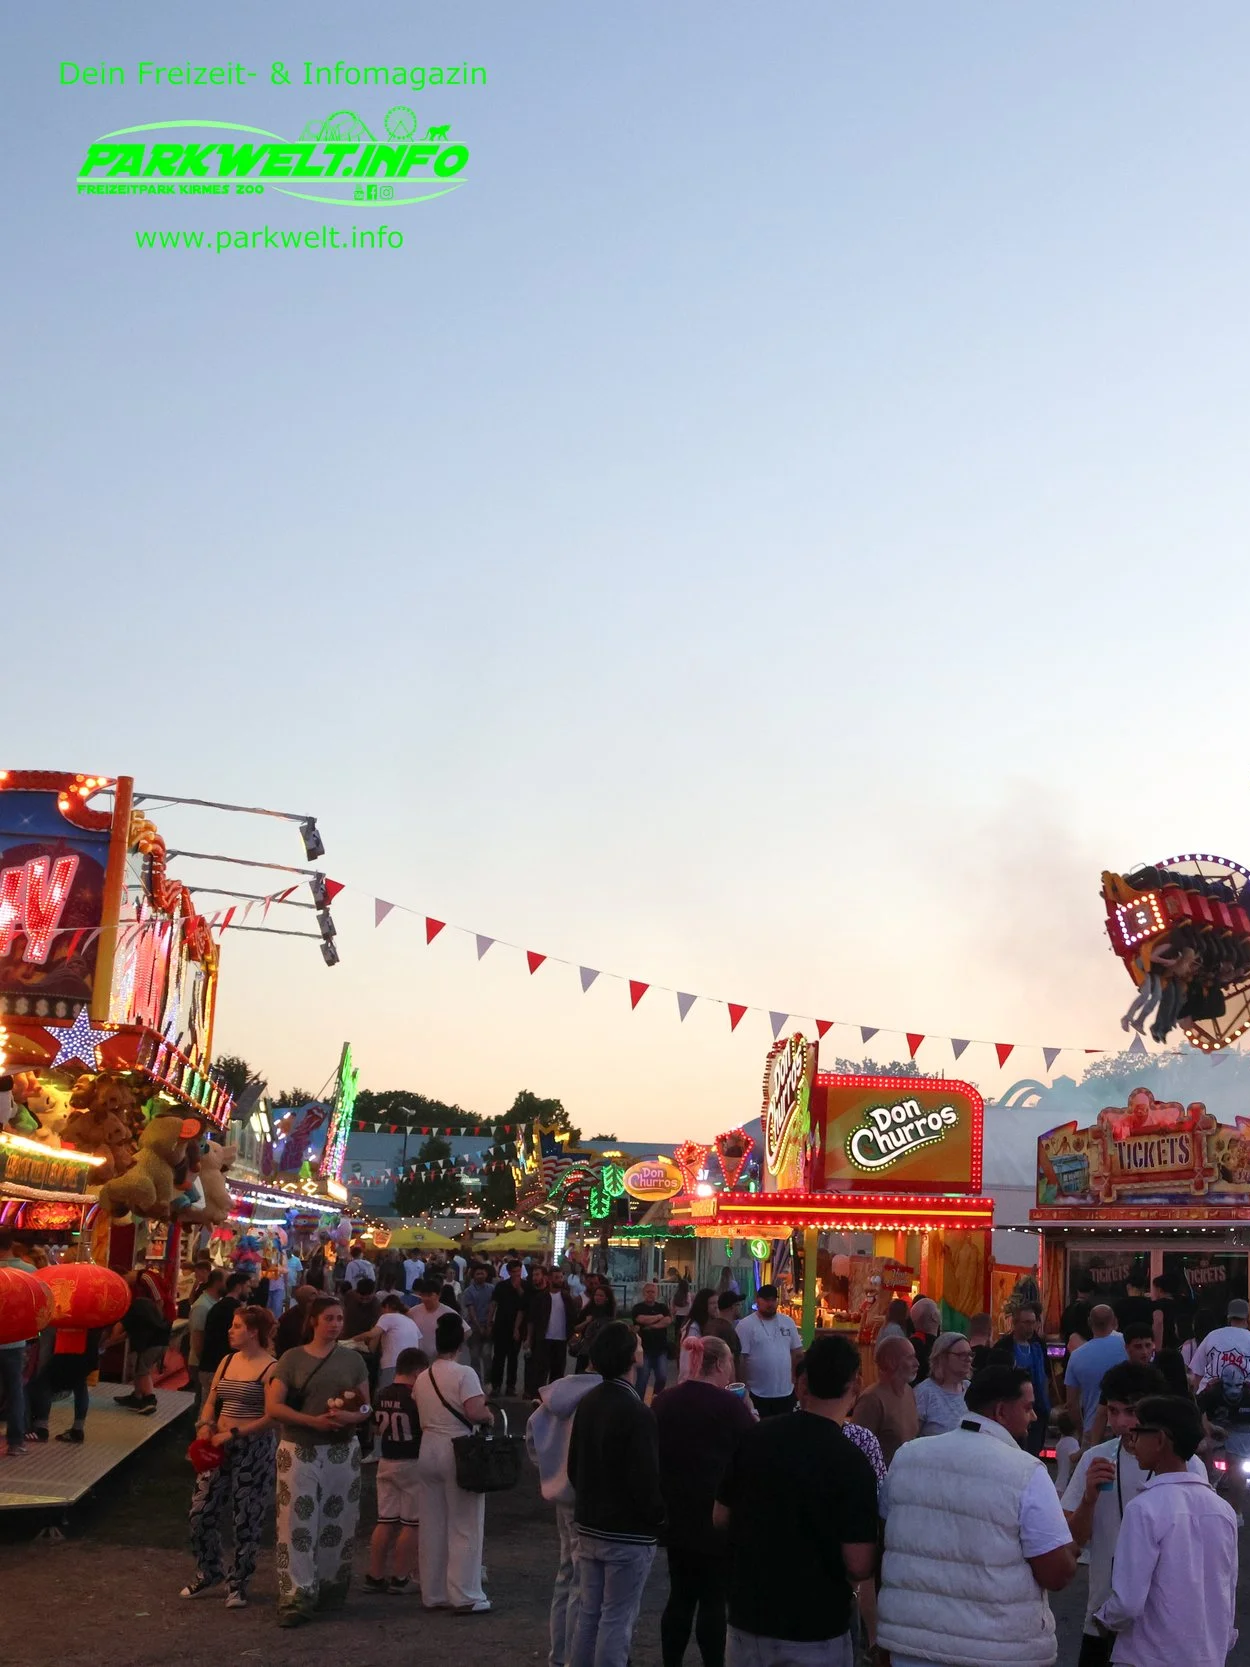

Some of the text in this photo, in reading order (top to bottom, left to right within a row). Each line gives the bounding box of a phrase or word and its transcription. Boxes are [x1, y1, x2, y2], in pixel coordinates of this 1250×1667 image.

[869, 1099, 921, 1132] Don
[851, 1106, 957, 1167] Churros
[1113, 1134, 1190, 1170] TICKETS
[628, 1173, 678, 1190] Churros
[643, 1167, 664, 1178] Don
[1089, 1264, 1130, 1284] TICKETS
